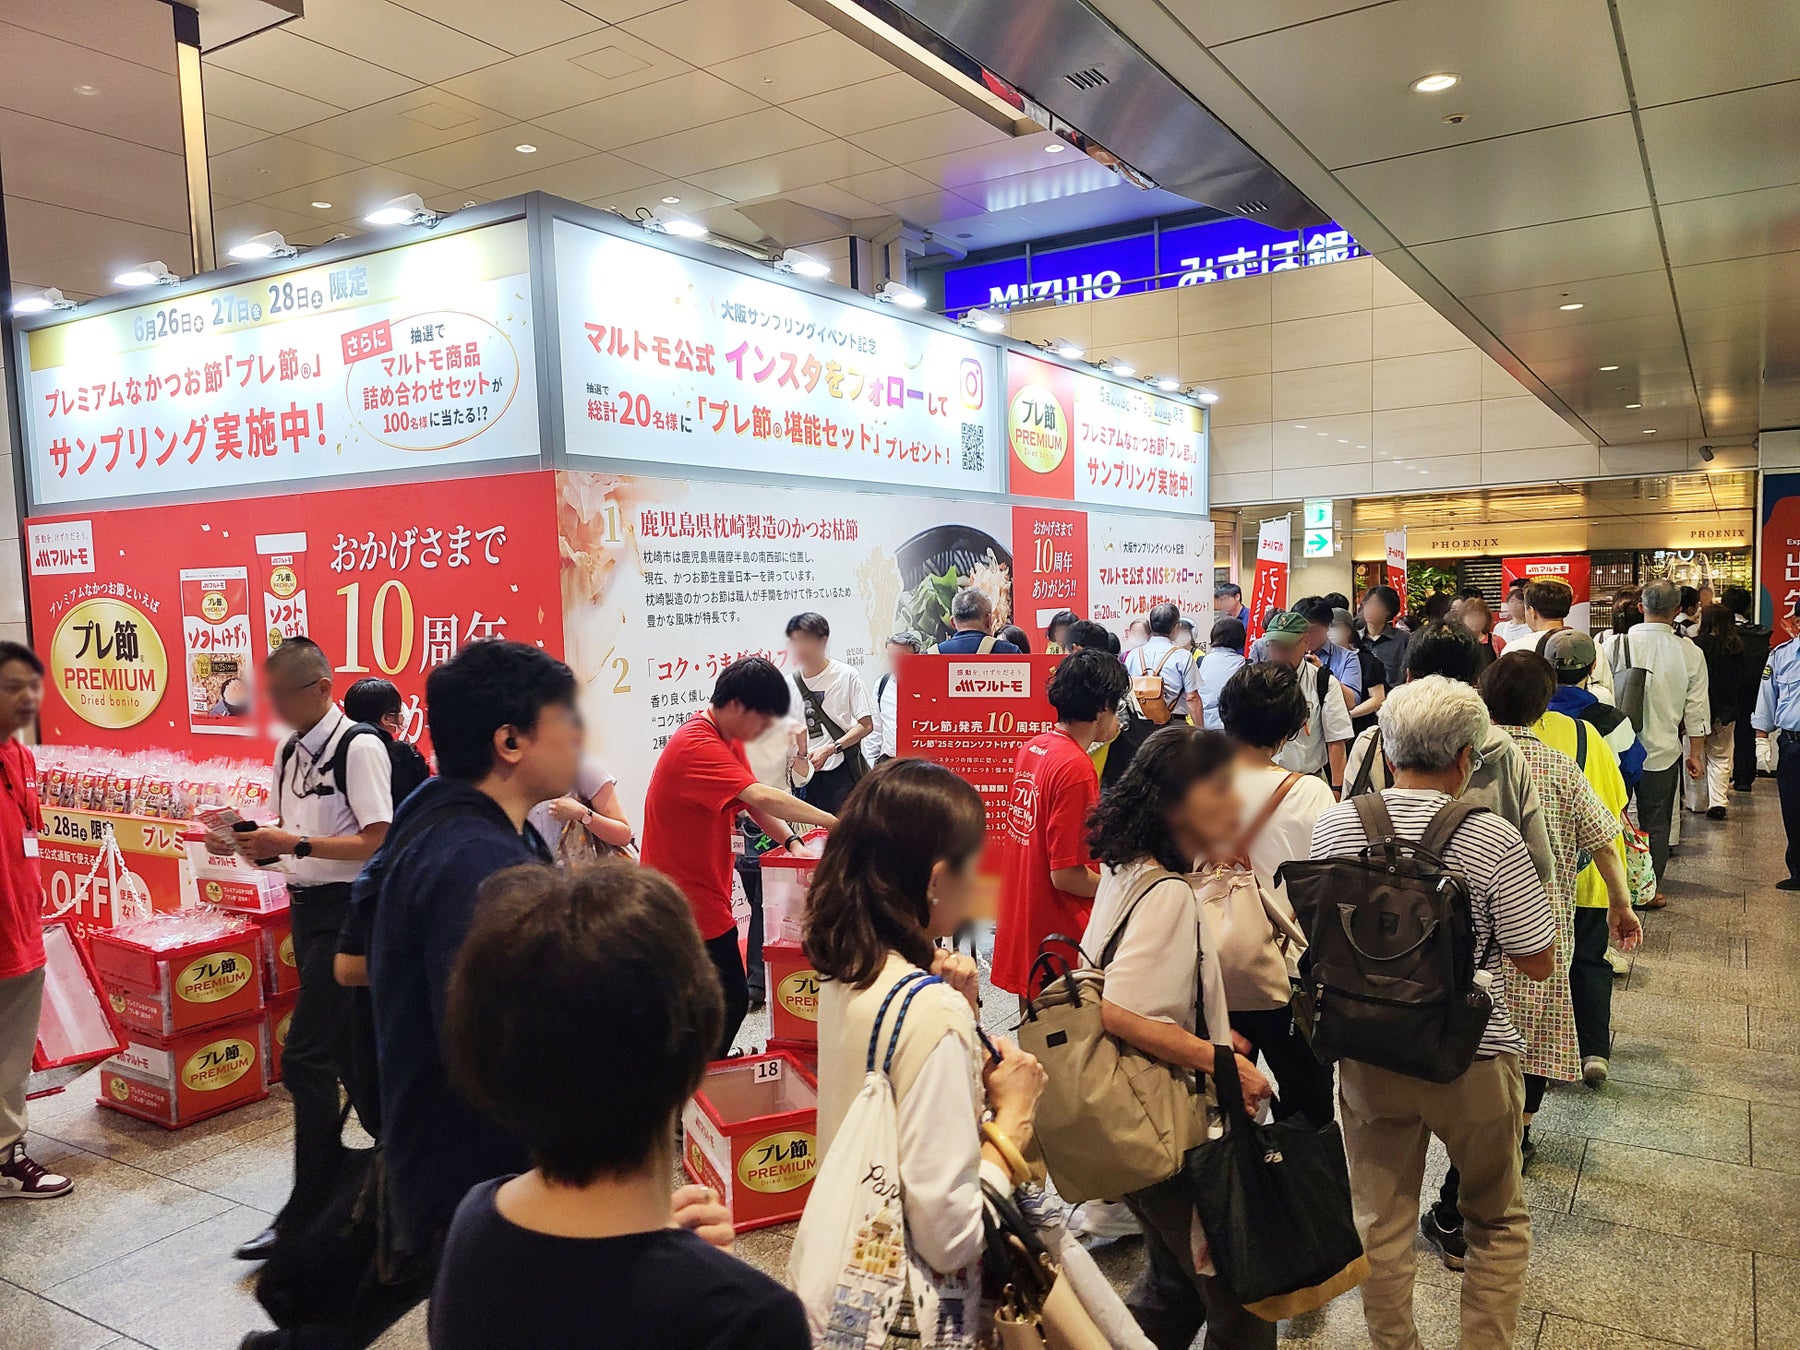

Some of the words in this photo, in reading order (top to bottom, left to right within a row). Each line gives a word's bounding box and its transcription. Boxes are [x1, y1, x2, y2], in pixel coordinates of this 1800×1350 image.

[1178, 231, 1361, 287] みずほ銀
[328, 266, 369, 301] 限定
[989, 270, 1121, 308] MIZUHO
[346, 328, 387, 357] さらに
[411, 324, 446, 345] 抽選で
[381, 341, 482, 379] マルトモ商品
[584, 321, 716, 376] マルトモ公式
[726, 340, 949, 417] インスタをフォローして
[363, 371, 504, 411] 詰め合わせセットが
[586, 381, 610, 397] 抽選で
[49, 401, 326, 479] サンプリング実施中!
[1015, 428, 1063, 451] PREMIUM
[1087, 457, 1194, 498] サンプリング実施中!
[640, 510, 859, 542] 鹿児島県枕崎製造のかつお枯節
[1032, 520, 1074, 537] おかげさまで
[1690, 529, 1745, 539] PHOENIX
[330, 525, 508, 574] おかげさまで
[1032, 538, 1074, 574] 10周年
[1431, 538, 1500, 549] PHOENIX
[49, 548, 89, 566] マルトモ
[1538, 565, 1566, 574] マルトモ
[63, 667, 157, 692] PREMIUM
[611, 657, 632, 695] 2
[974, 679, 1023, 692] マルトモ
[80, 694, 106, 706] Dried
[108, 695, 140, 707] bonito
[912, 711, 1059, 734] 「プレ節」発売10周年記
[51, 869, 109, 919] OFF
[192, 957, 237, 982] プレ節
[184, 971, 246, 995] PREMIUM
[198, 1043, 241, 1070] プレ節
[190, 1057, 249, 1085] PREMIUM
[757, 1061, 779, 1079] 18
[757, 1139, 808, 1166] プレ節
[747, 1158, 817, 1182] PREMIUM
[760, 1176, 781, 1187] Dried
